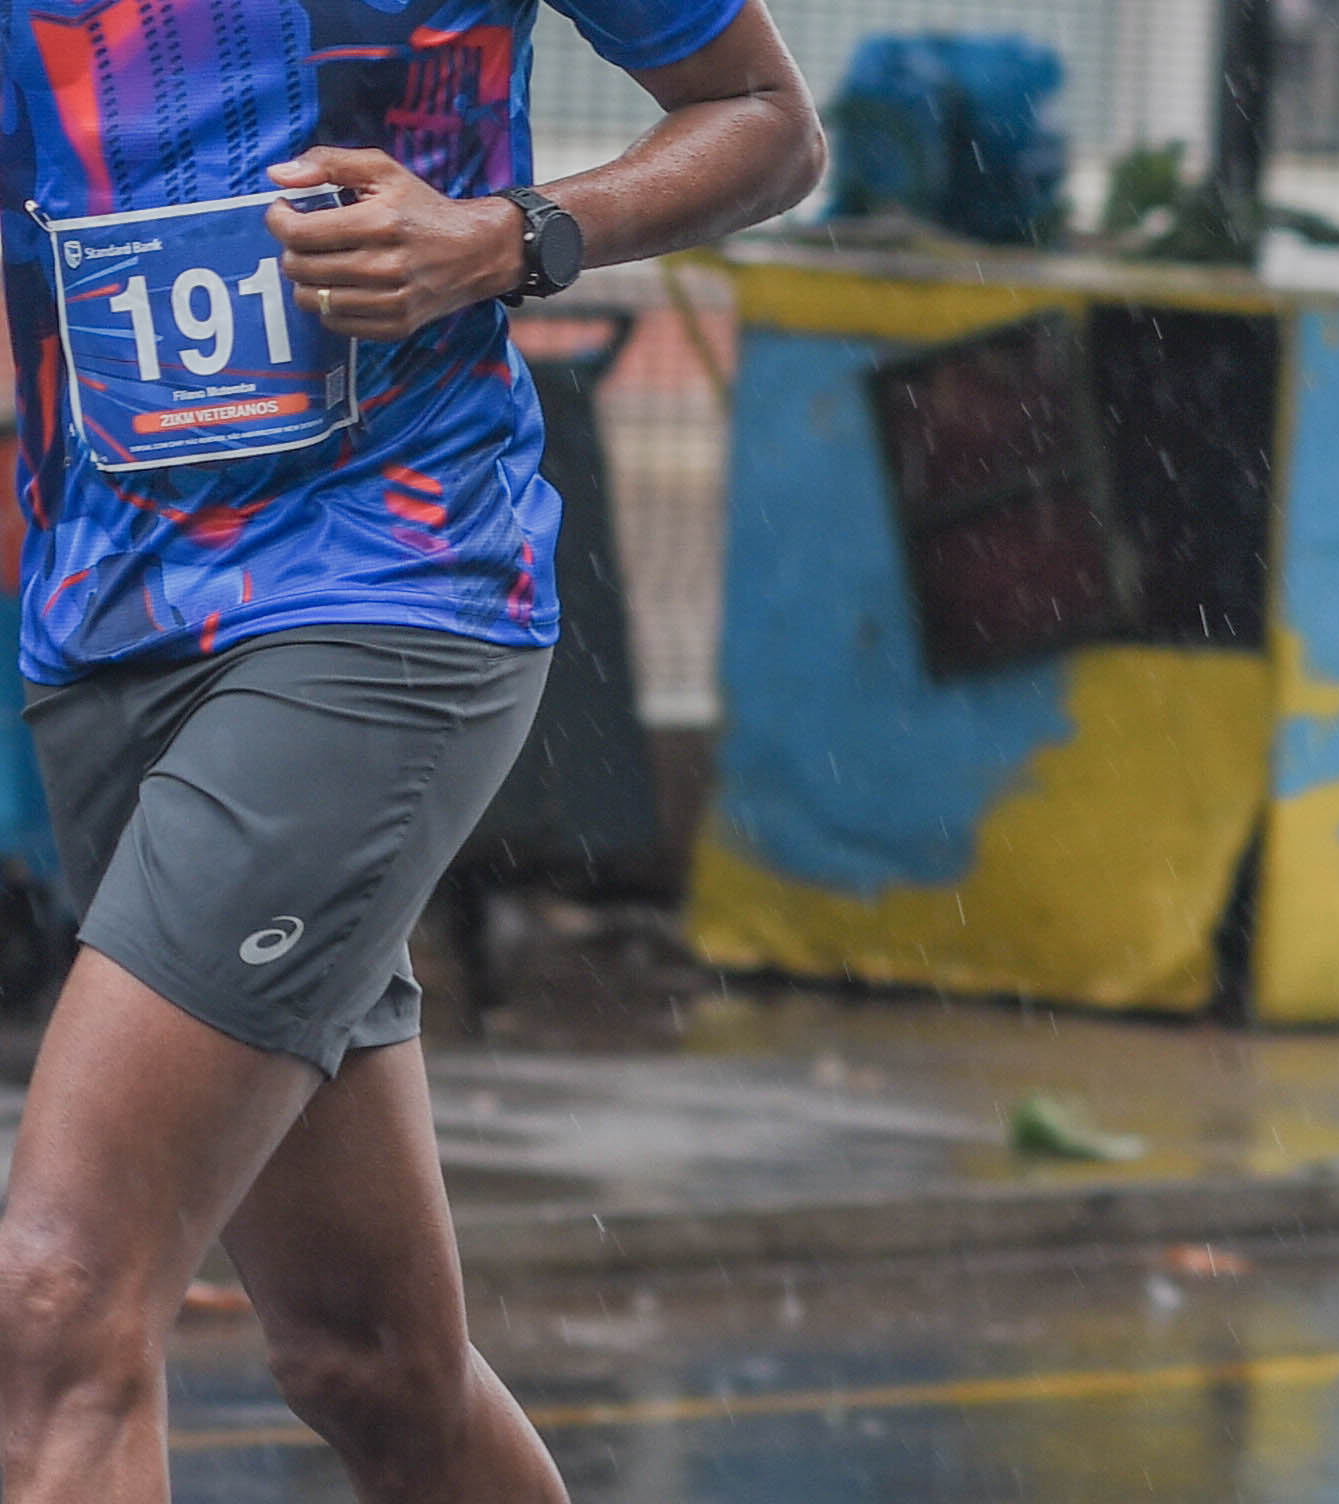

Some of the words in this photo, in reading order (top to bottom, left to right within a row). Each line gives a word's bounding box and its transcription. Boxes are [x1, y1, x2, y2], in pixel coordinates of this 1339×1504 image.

[133, 238, 163, 254] Bank
[110, 257, 292, 381] 191
[196, 400, 280, 422] VETERANOS
